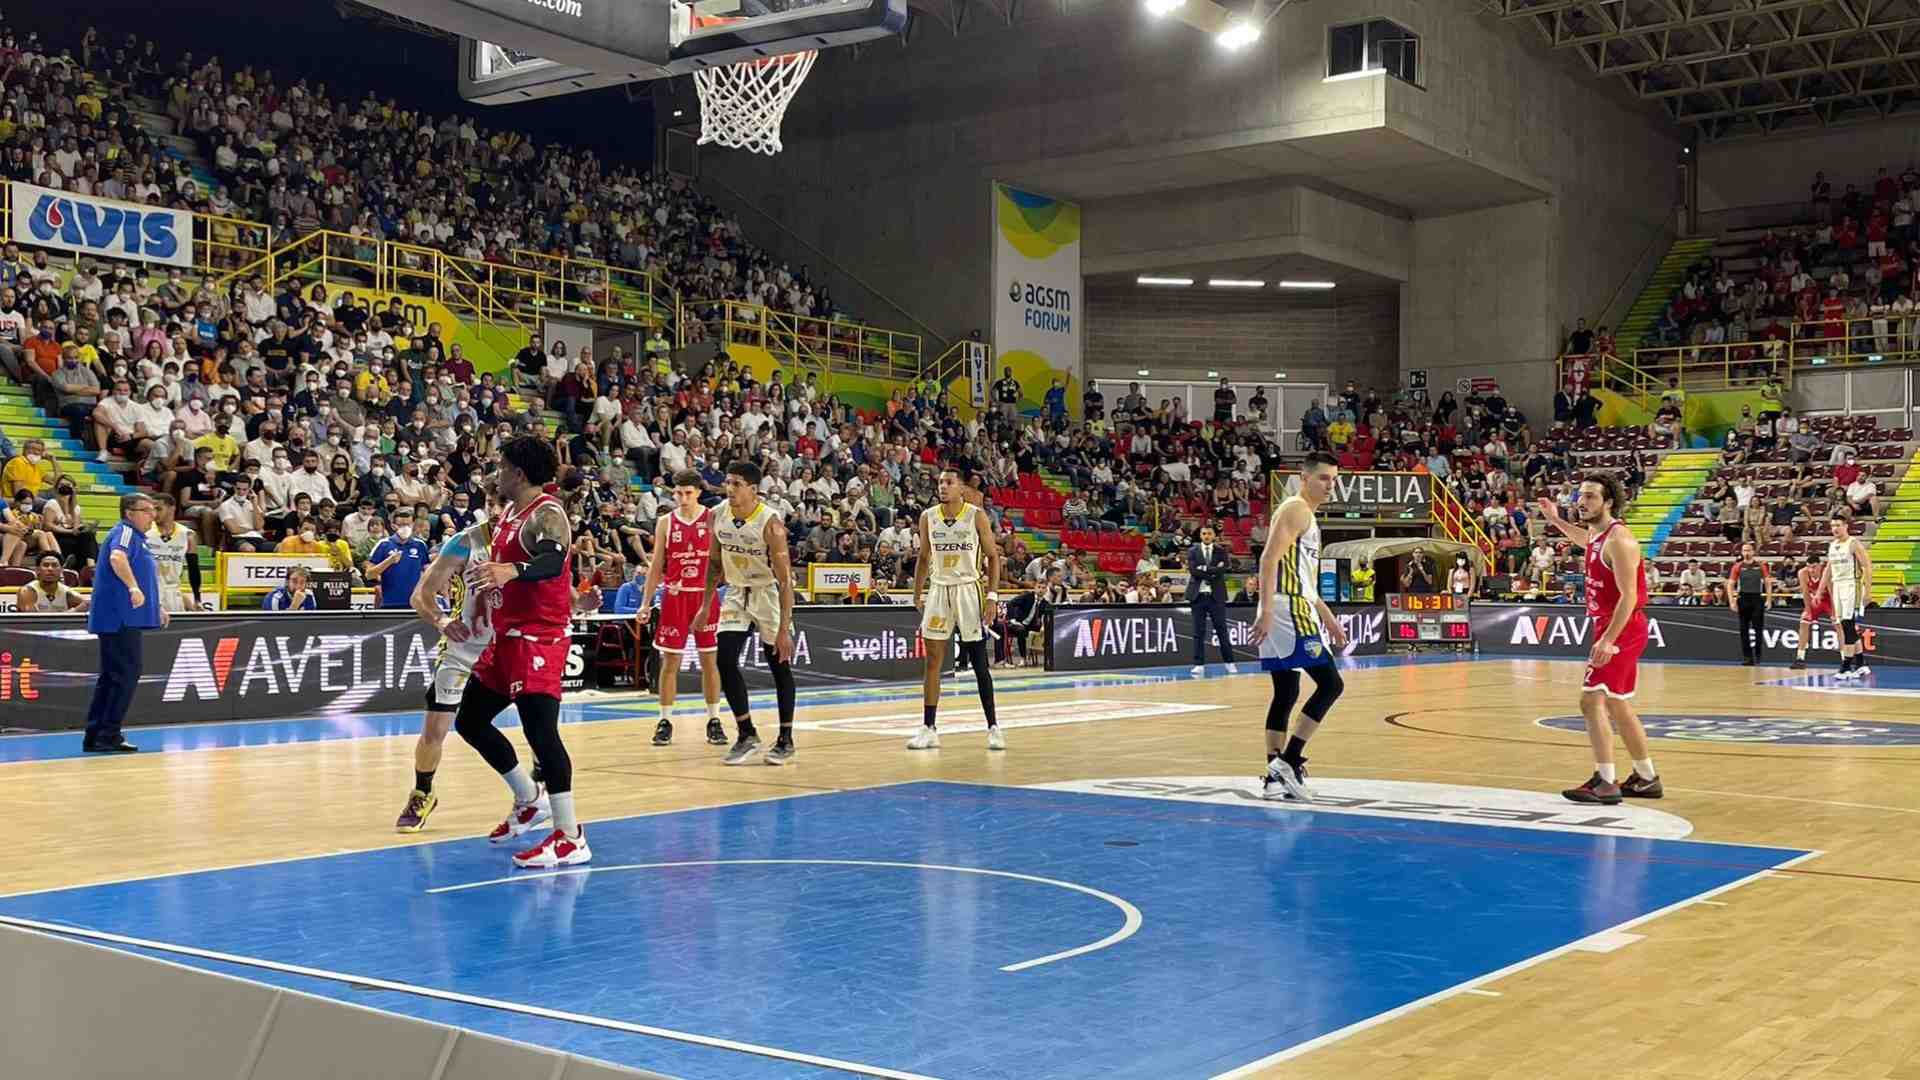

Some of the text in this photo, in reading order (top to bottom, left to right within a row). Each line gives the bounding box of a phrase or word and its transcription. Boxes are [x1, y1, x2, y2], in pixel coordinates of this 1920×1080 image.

[28, 194, 178, 258] AVIS
[1025, 308, 1071, 334] FORUM
[1408, 595, 1452, 610] 16:31
[1101, 617, 1178, 656] AVELIA
[238, 633, 433, 697] AVELIA
